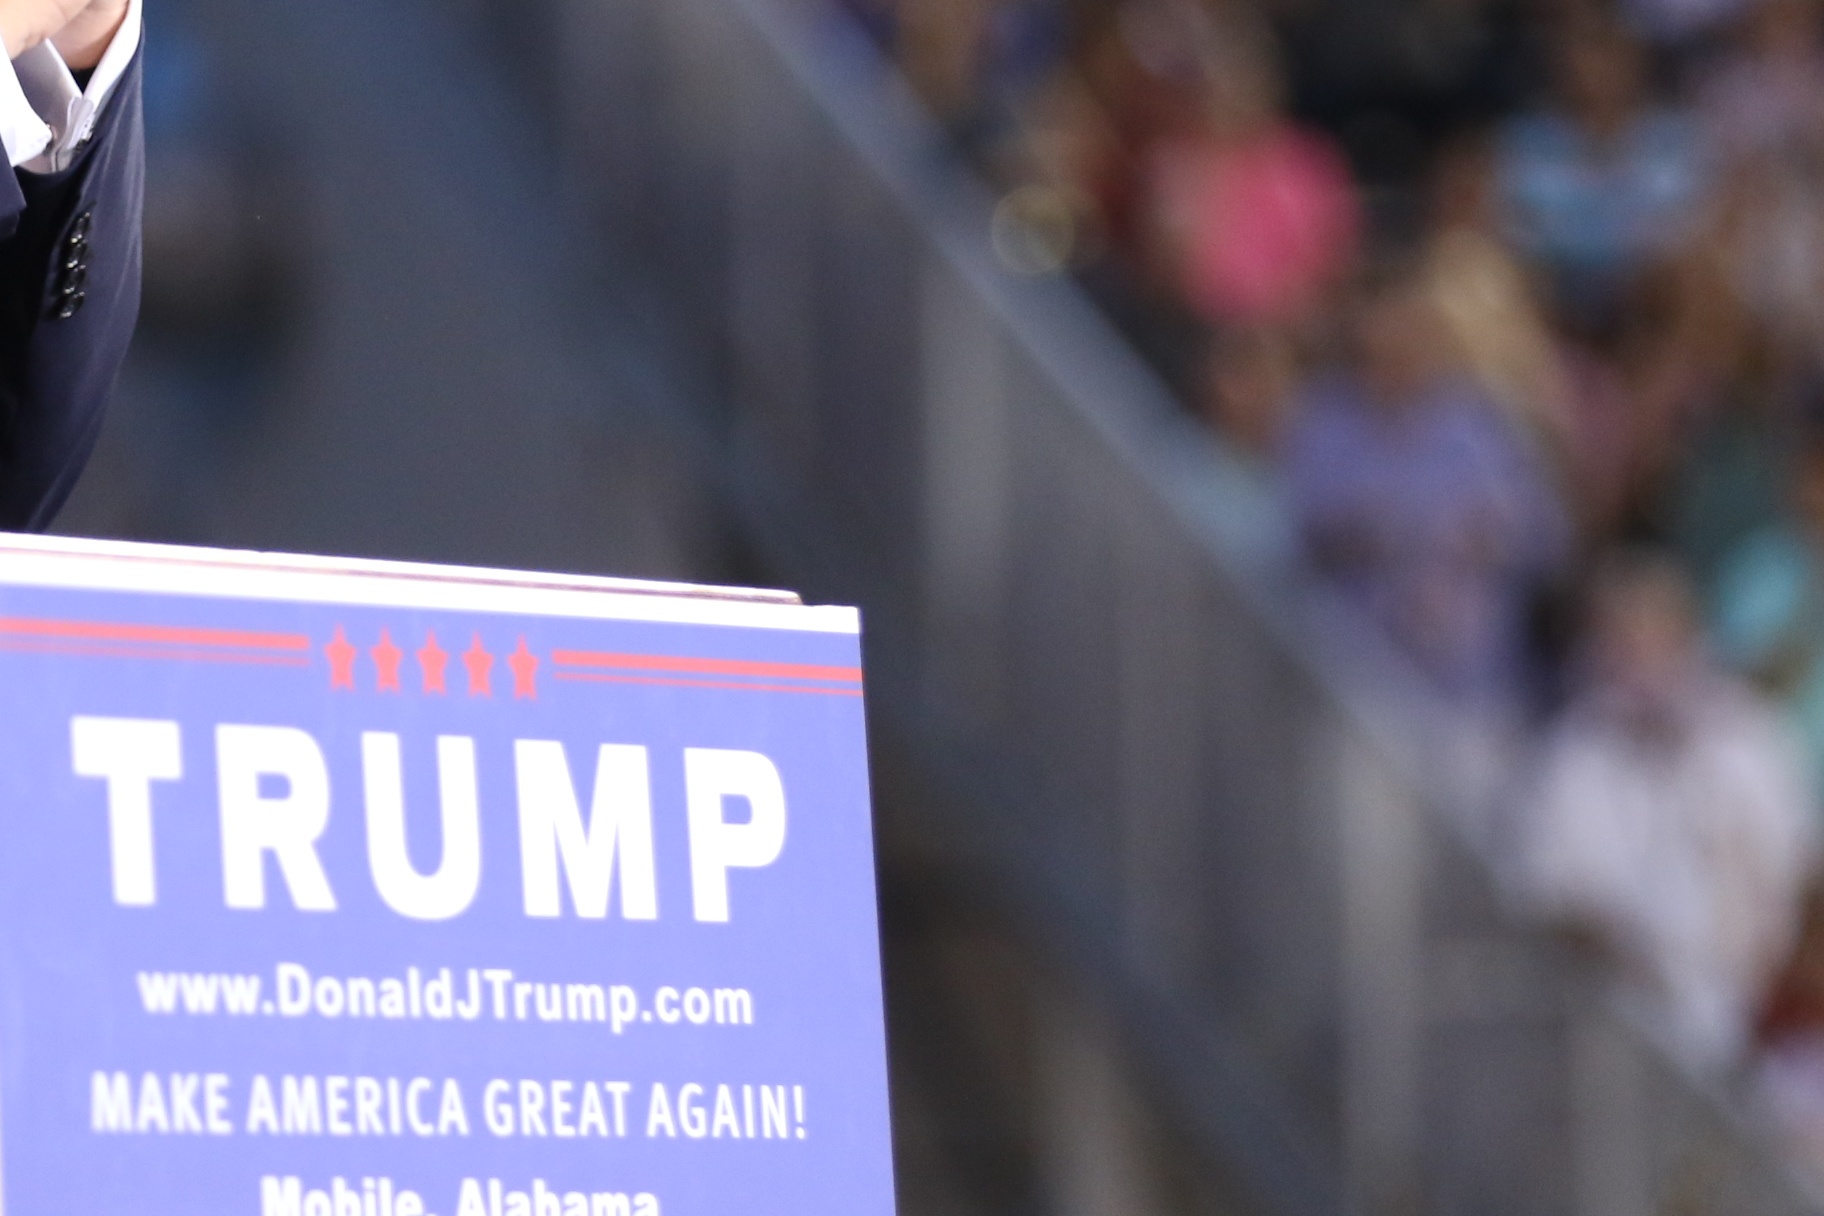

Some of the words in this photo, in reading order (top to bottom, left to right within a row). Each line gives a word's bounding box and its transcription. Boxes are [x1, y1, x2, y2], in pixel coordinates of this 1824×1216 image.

[71, 715, 787, 923] TRUMP
[137, 962, 754, 1034] www.DonaldJTrump.com
[91, 1072, 233, 1135] MAKE
[247, 1074, 470, 1136] AMERICA
[483, 1079, 631, 1138] GREAT
[646, 1082, 806, 1140] AGAIN!
[260, 1175, 438, 1216] Mobile
[456, 1177, 660, 1216] Alabama
